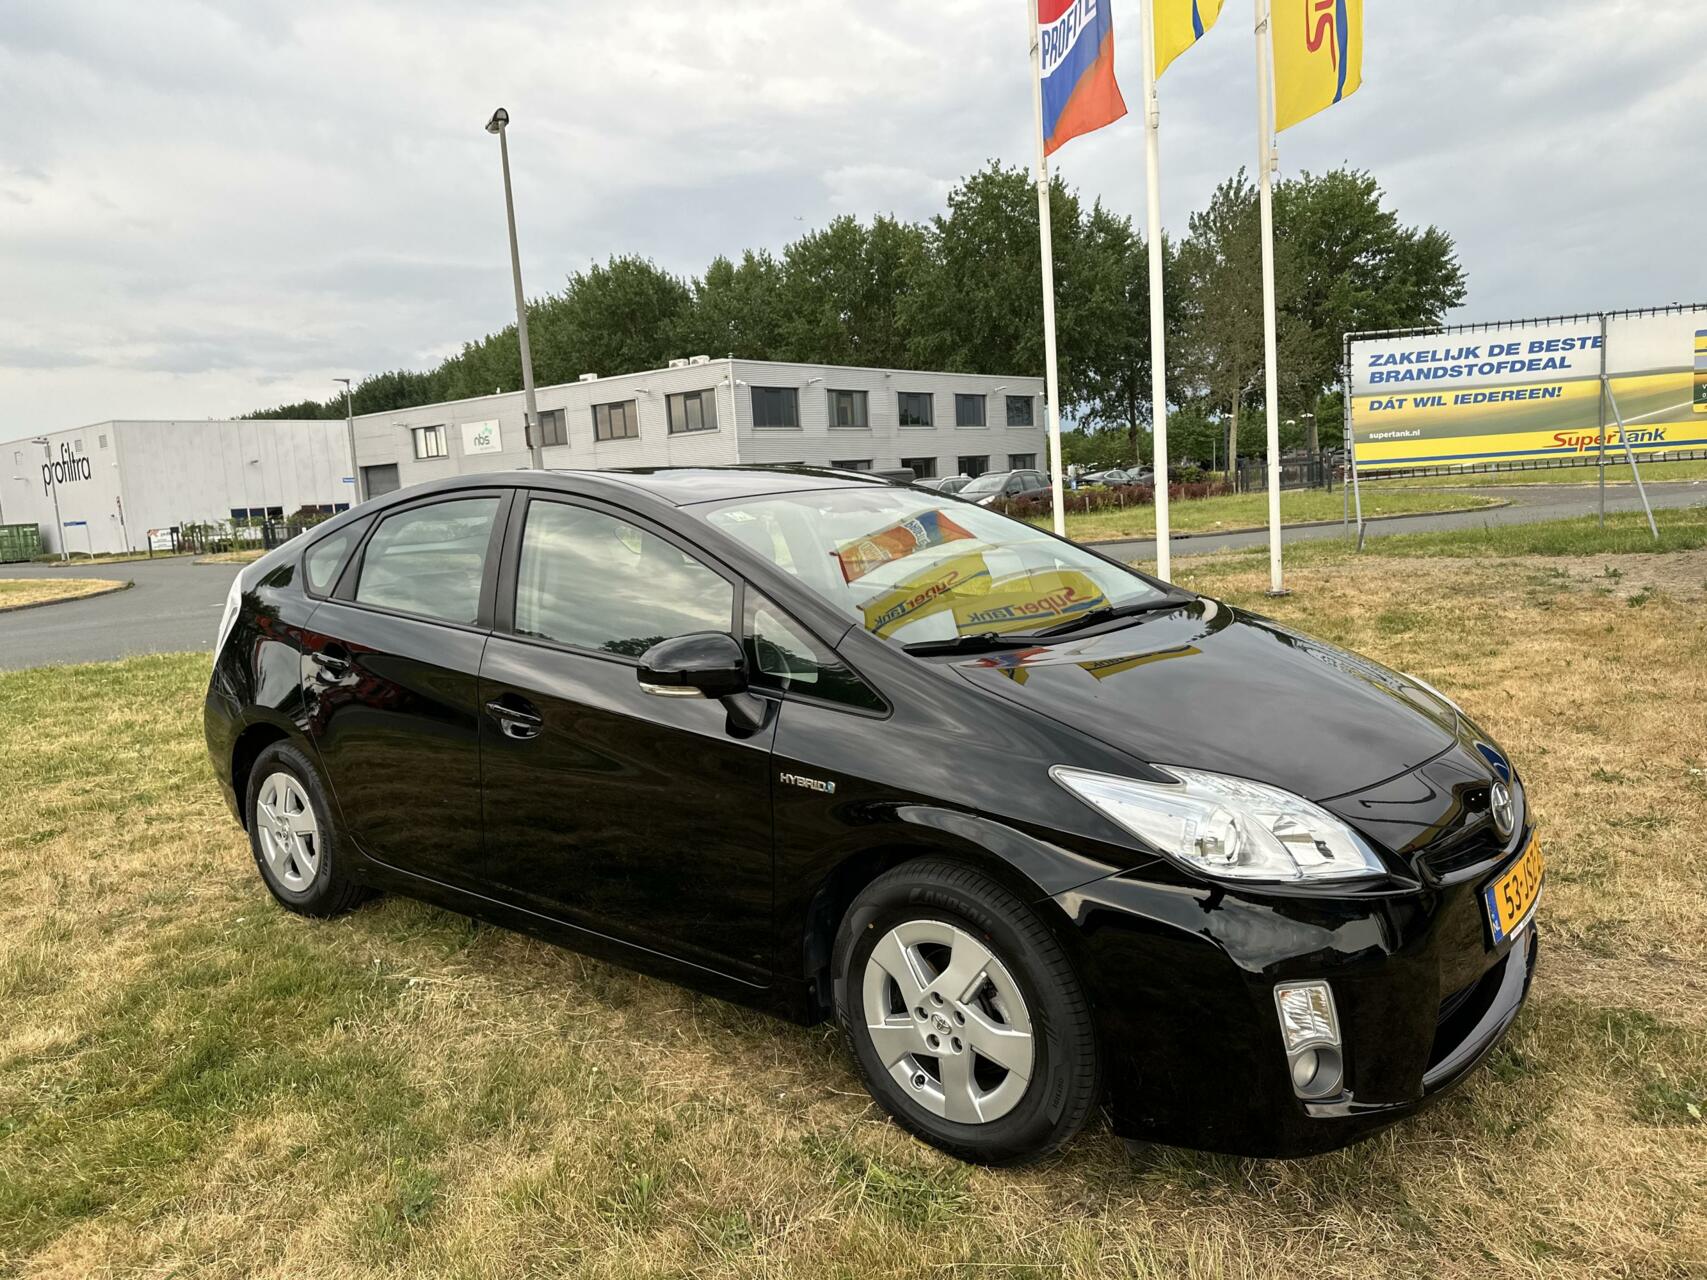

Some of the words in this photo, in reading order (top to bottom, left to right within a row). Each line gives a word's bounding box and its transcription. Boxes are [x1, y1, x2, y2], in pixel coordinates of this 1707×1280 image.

[1368, 346, 1482, 367] ZAKELIJK
[1488, 342, 1521, 358] DE
[1528, 335, 1603, 354] BESTE
[1369, 356, 1572, 384] BRANDSTOFDEAL
[1369, 396, 1408, 411] DÁT
[1413, 395, 1447, 409] WIL
[1453, 386, 1563, 405] IEDEREEN!
[473, 433, 491, 447] nbs
[1369, 429, 1421, 439] supertank.nl
[41, 442, 92, 497] profiltra
[780, 772, 827, 793] HYBRID
